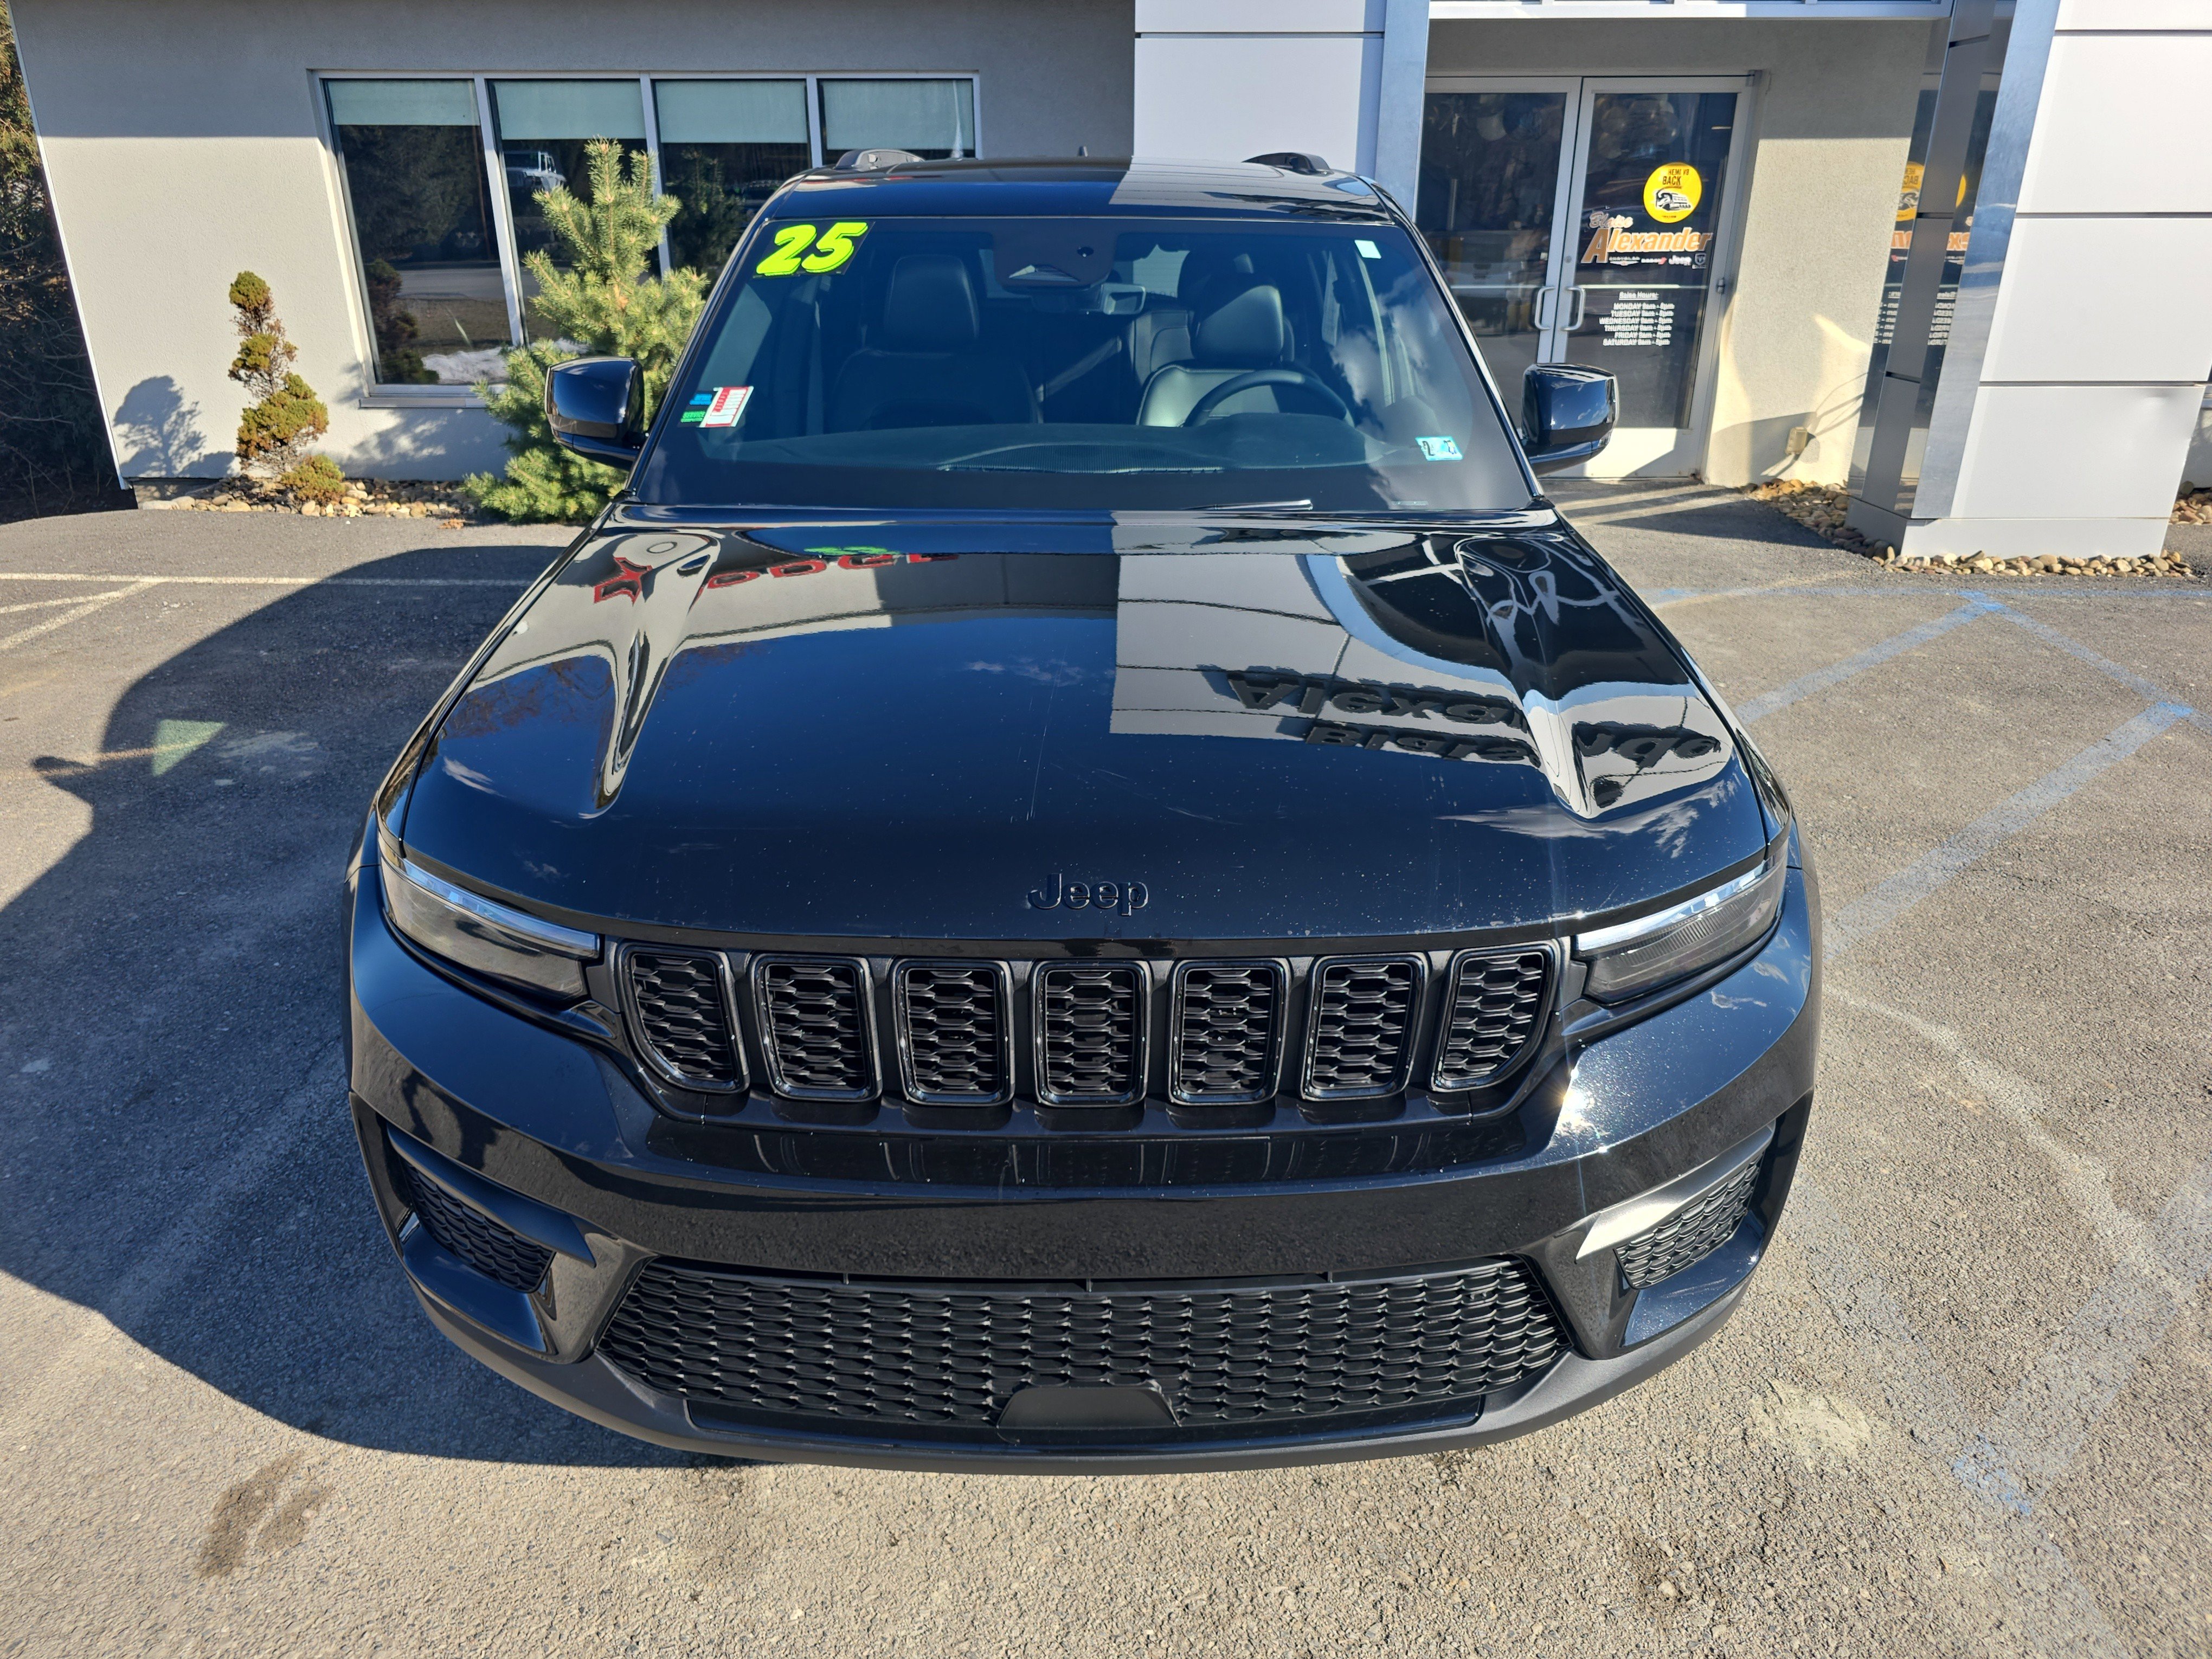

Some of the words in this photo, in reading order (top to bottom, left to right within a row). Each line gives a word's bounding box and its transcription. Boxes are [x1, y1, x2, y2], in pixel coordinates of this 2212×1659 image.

[1662, 176, 1681, 185] BACK
[756, 222, 867, 276] 25
[1580, 227, 1713, 263] Alexander
[1028, 873, 1148, 916] Jeep
